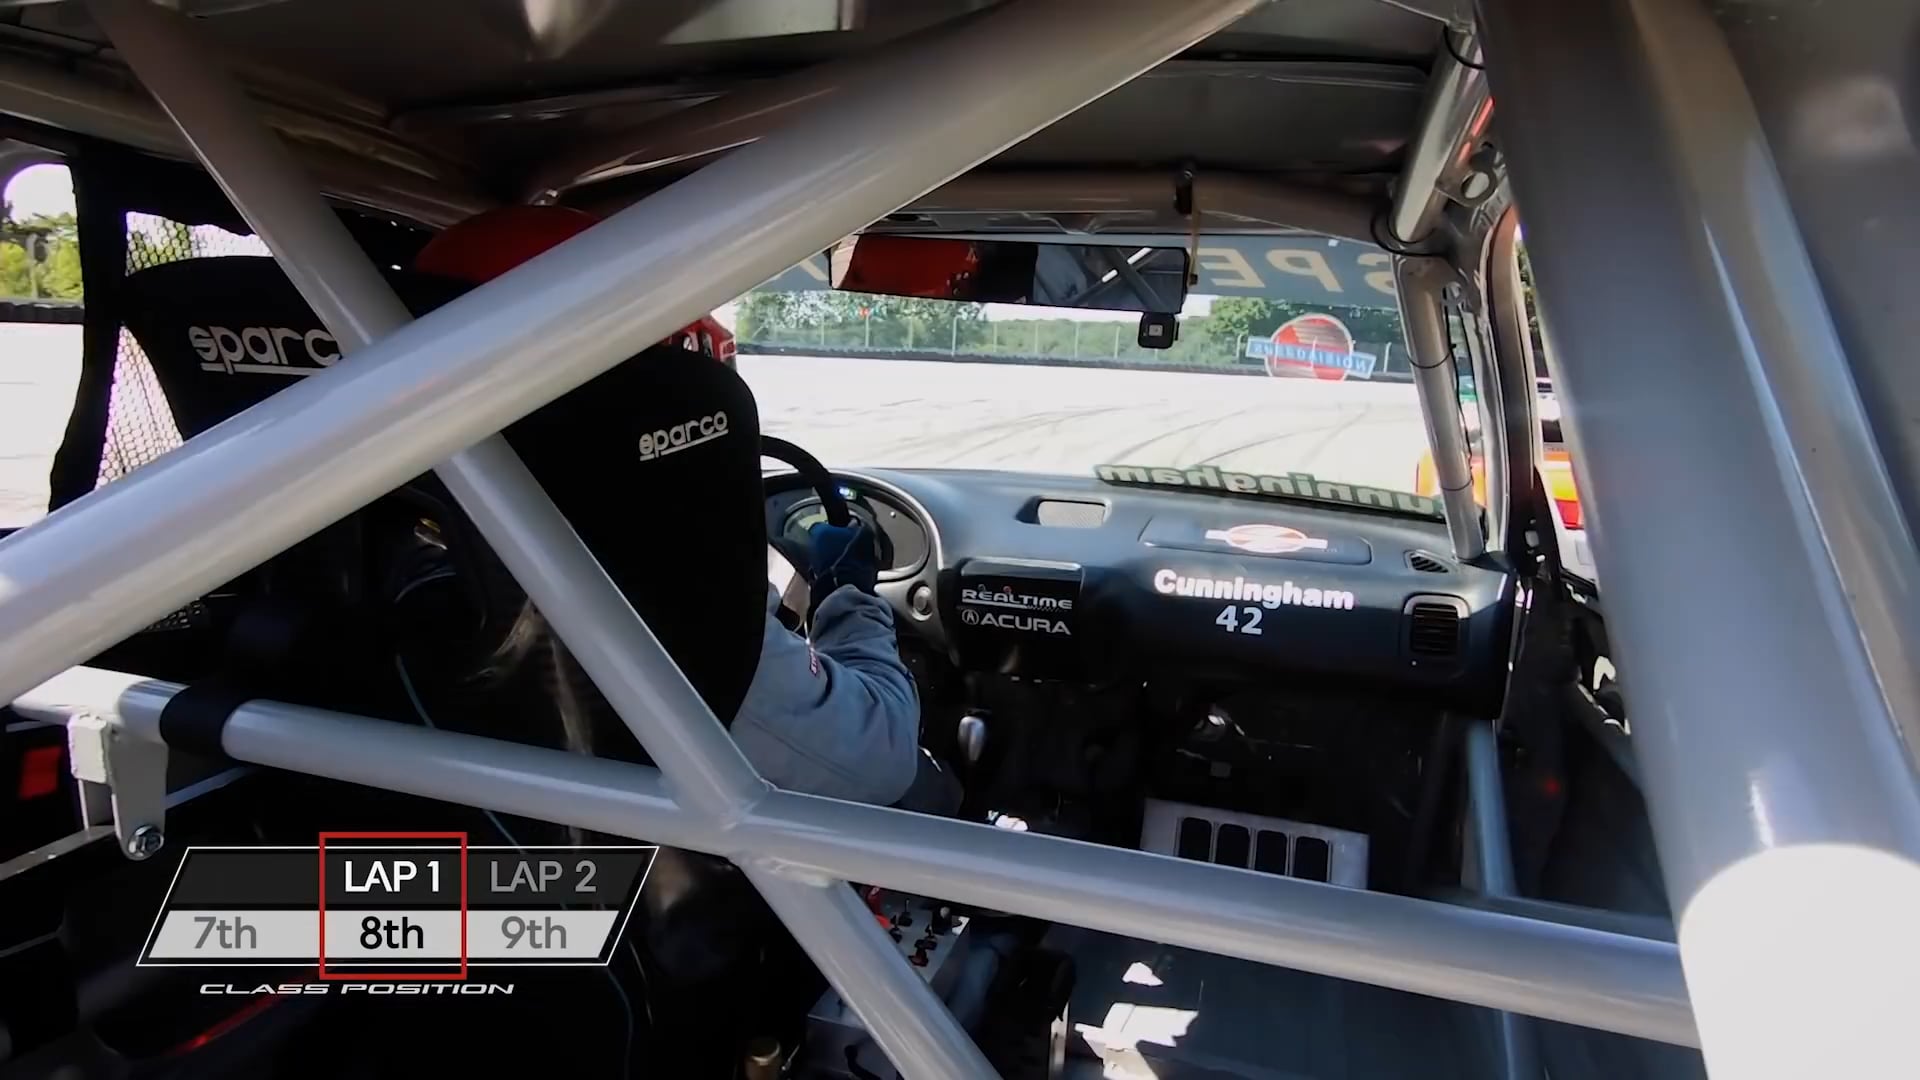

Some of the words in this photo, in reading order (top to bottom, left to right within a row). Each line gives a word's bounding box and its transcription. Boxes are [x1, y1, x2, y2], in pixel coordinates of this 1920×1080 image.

[188, 326, 342, 375] sparc
[639, 411, 729, 461] sparco
[962, 588, 1072, 610] REALTIME
[1154, 569, 1354, 610] Cunningham
[980, 612, 1072, 635] ACURA
[1215, 605, 1263, 635] 42
